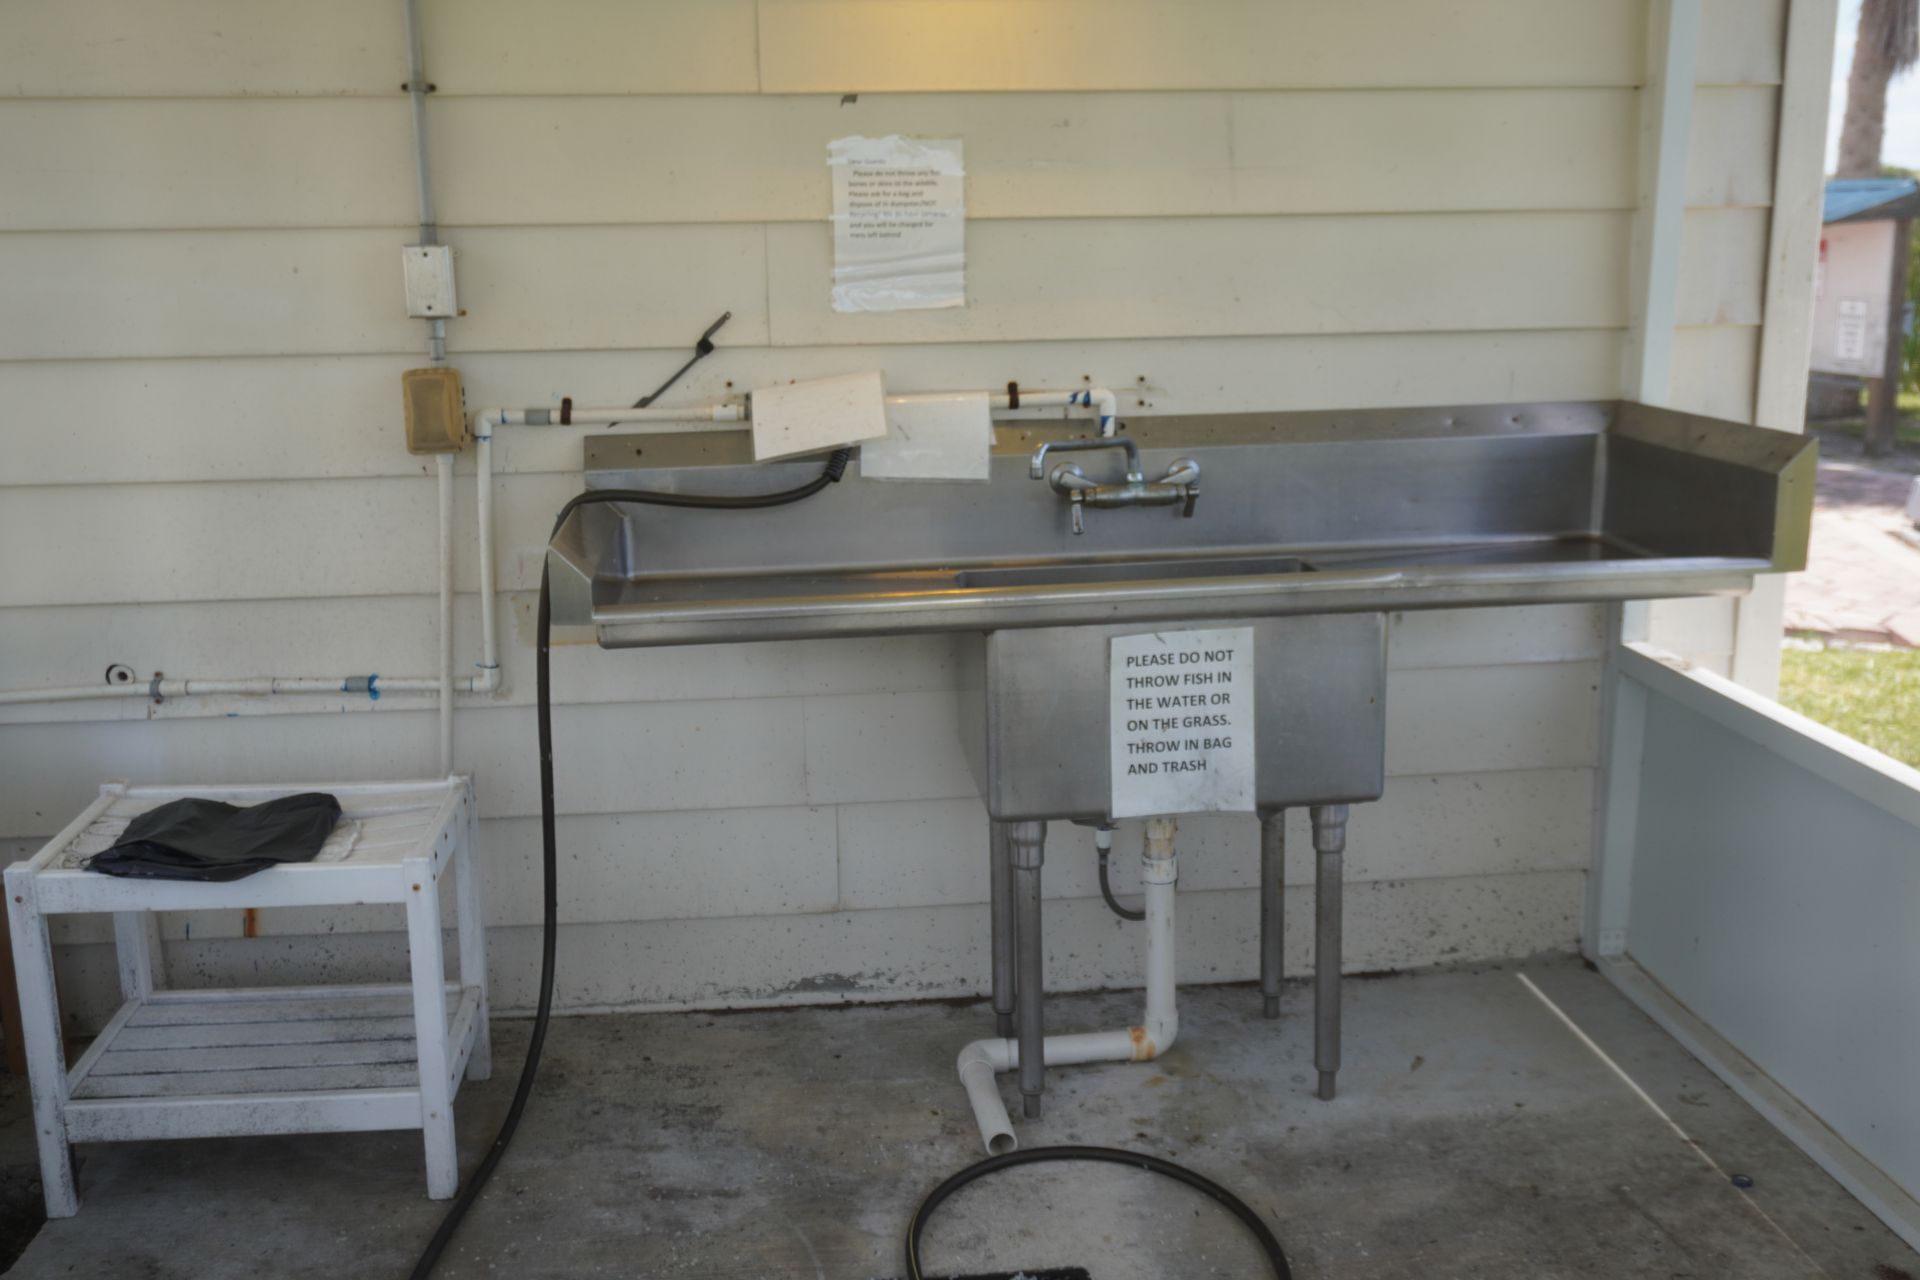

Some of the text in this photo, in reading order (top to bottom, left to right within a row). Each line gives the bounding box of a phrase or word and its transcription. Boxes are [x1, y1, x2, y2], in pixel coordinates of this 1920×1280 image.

[898, 190, 910, 198] bag
[898, 222, 923, 230] charged
[1127, 650, 1234, 668] PLEASE DO NOT
[1126, 672, 1232, 689] THROW FISH IN
[1126, 693, 1230, 710] THE WATER OR
[1127, 715, 1231, 732] ON THE GRASS.
[1127, 737, 1232, 754] THROW IN BAG
[1128, 760, 1207, 775] AND TRASH
